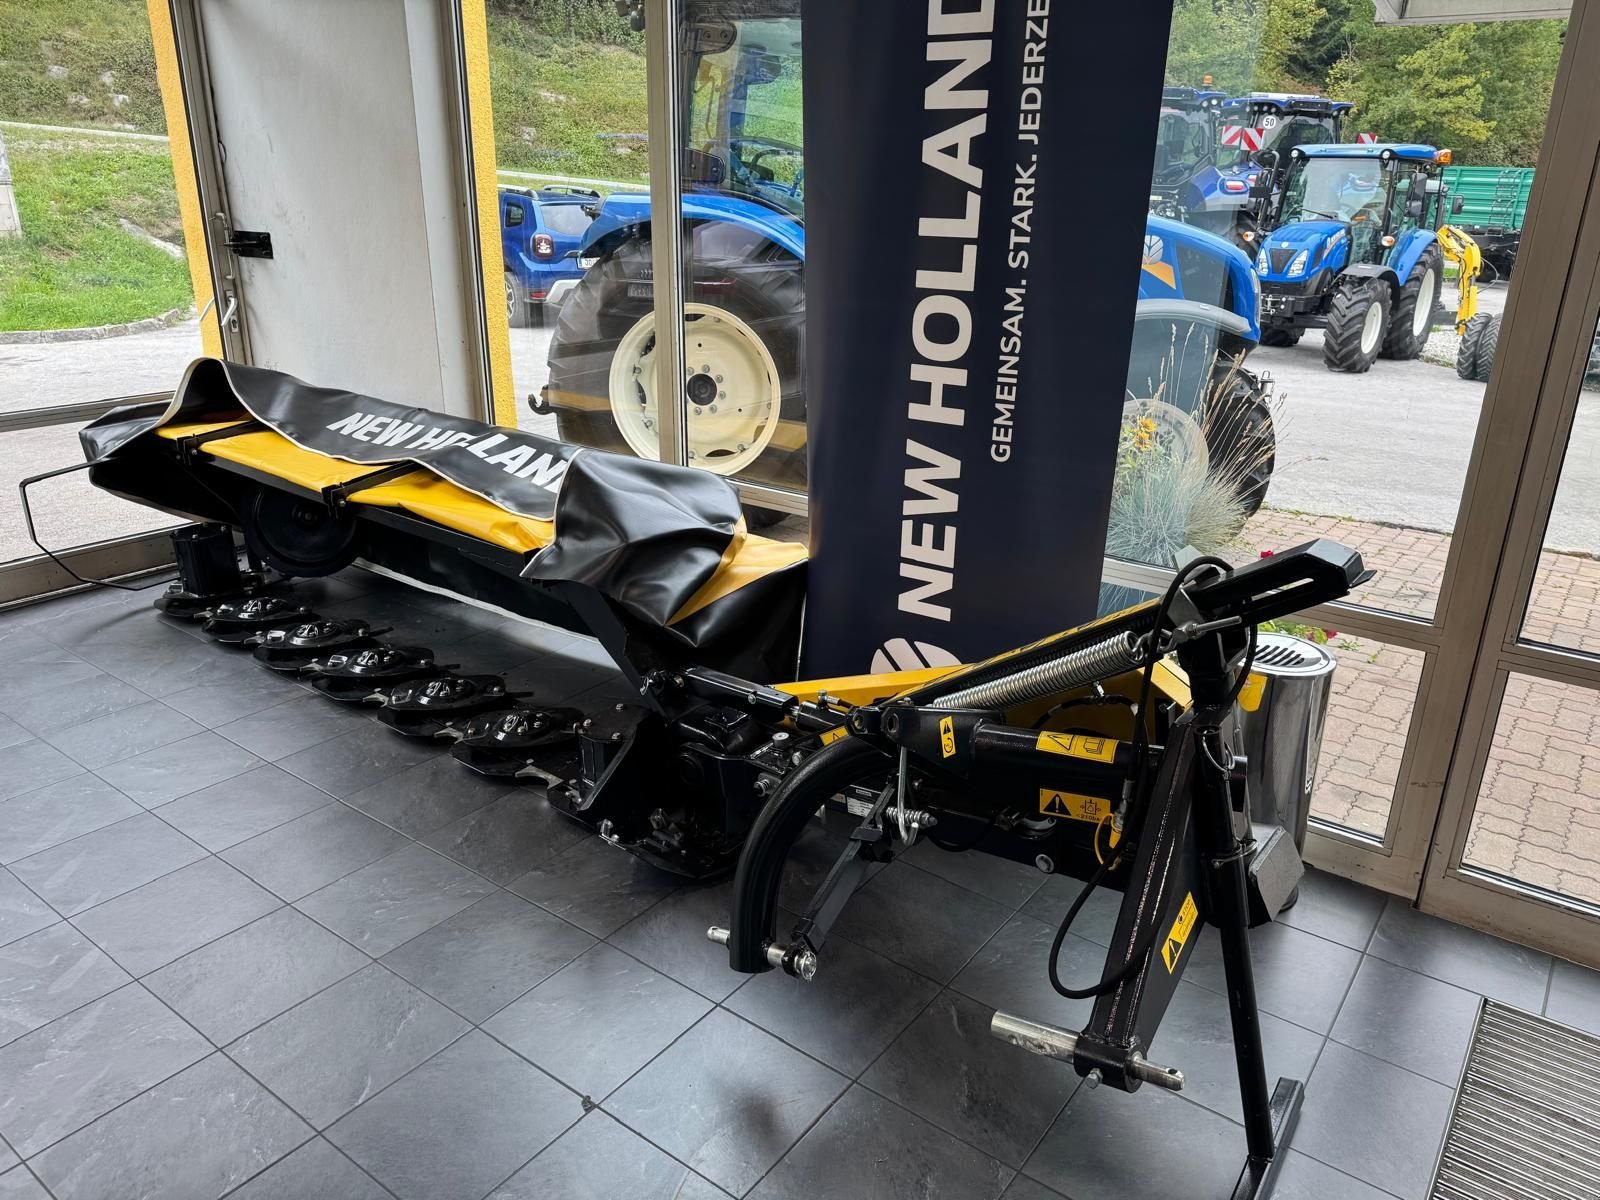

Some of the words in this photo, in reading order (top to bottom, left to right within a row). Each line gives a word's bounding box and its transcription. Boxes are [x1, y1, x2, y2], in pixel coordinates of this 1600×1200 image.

[1264, 117, 1275, 127] 50
[1007, 154, 1038, 269] STARK.
[990, 279, 1027, 463] GEMEINSAM.
[326, 412, 426, 448] NEW
[898, 438, 961, 622] NEW
